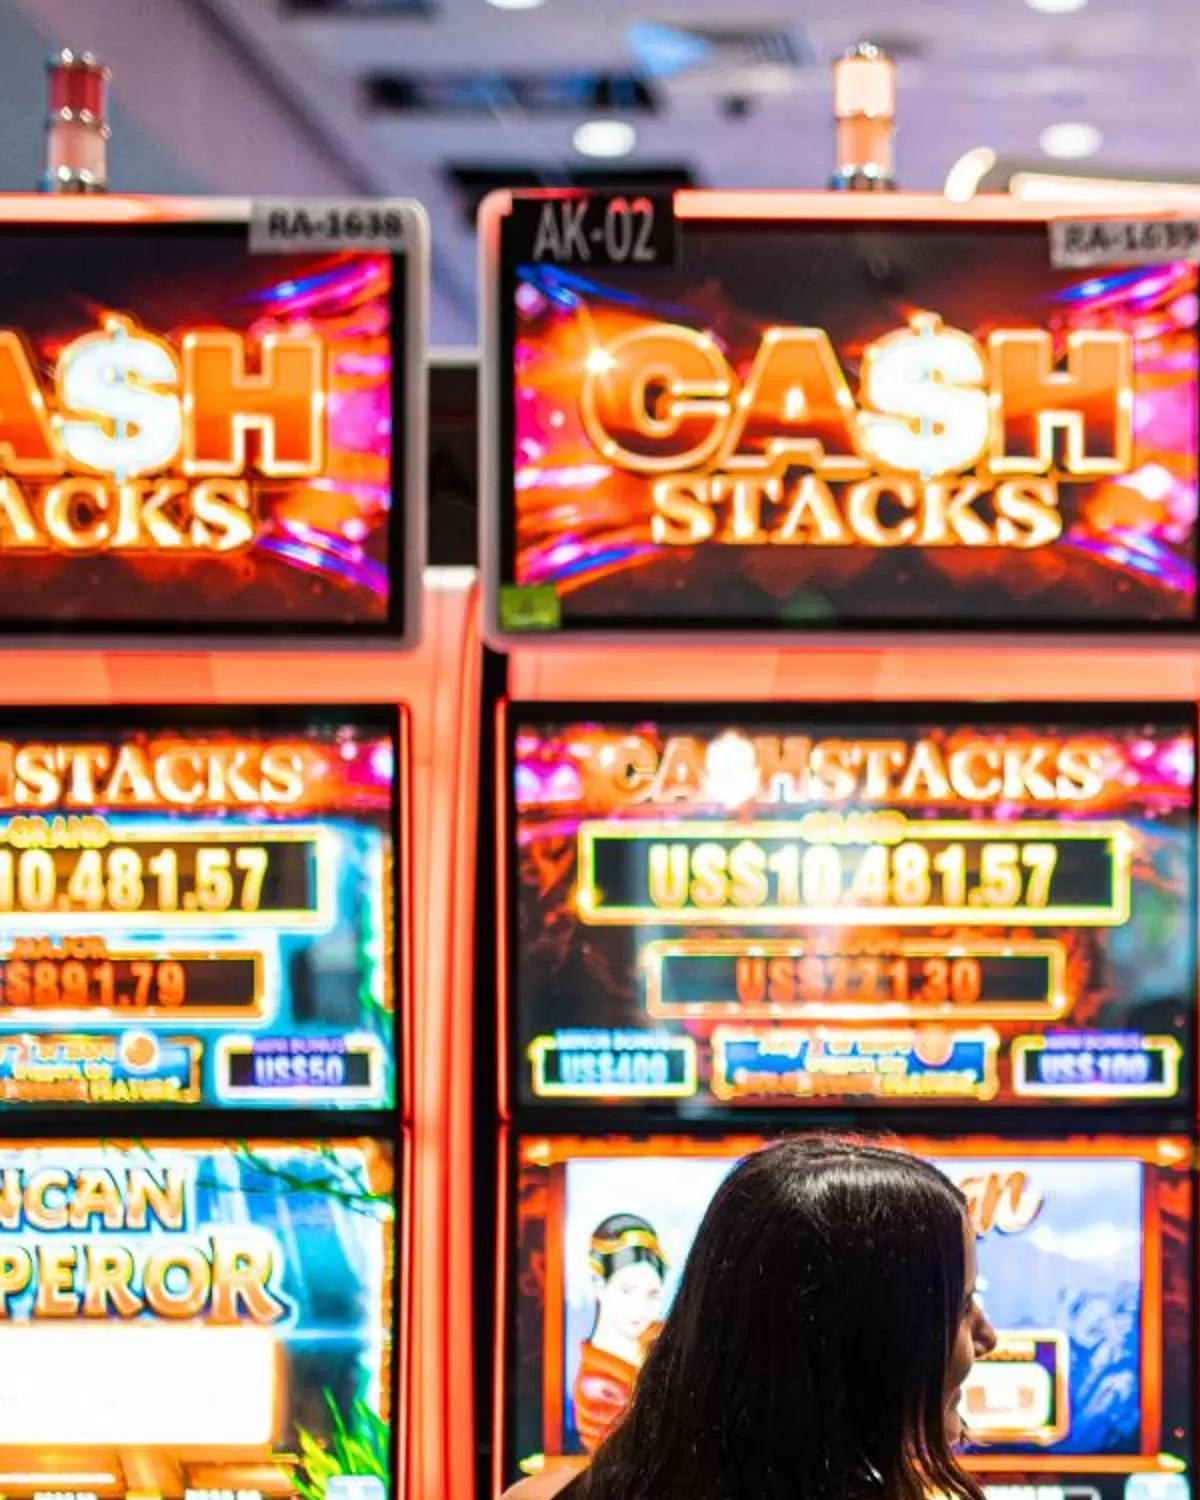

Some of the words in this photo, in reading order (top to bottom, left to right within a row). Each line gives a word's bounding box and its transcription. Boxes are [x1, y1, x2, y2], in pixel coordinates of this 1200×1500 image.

[531, 199, 657, 262] AK-02
[651, 473, 1064, 549] STACKS
[13, 744, 306, 806] STACKS
[808, 738, 1108, 803] STACKS
